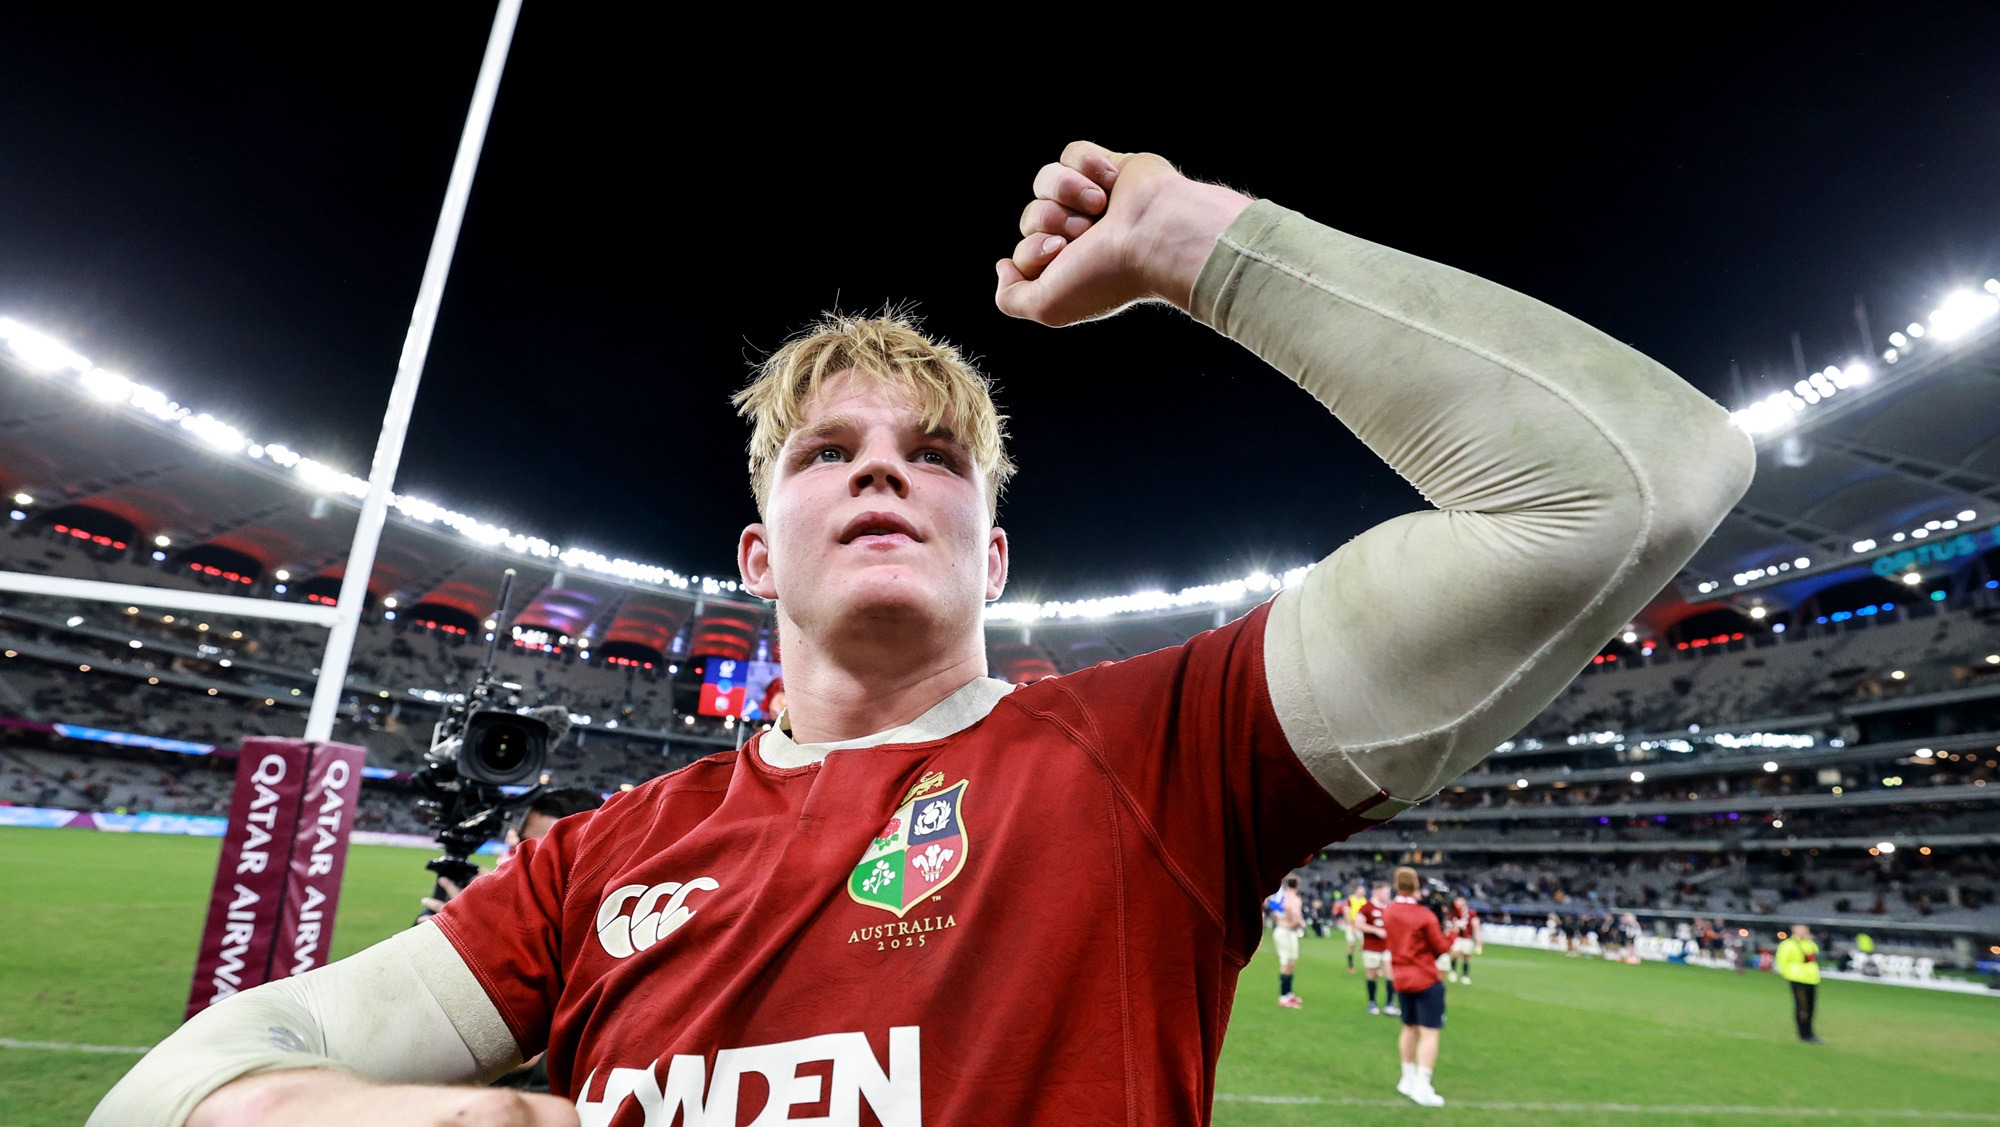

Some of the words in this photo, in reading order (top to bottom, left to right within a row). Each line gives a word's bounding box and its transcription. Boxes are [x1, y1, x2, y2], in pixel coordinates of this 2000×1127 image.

[236, 754, 287, 875] QATAR
[307, 759, 350, 877] QATAR
[847, 914, 957, 944] AUSTRALIA
[877, 934, 926, 951] 2025
